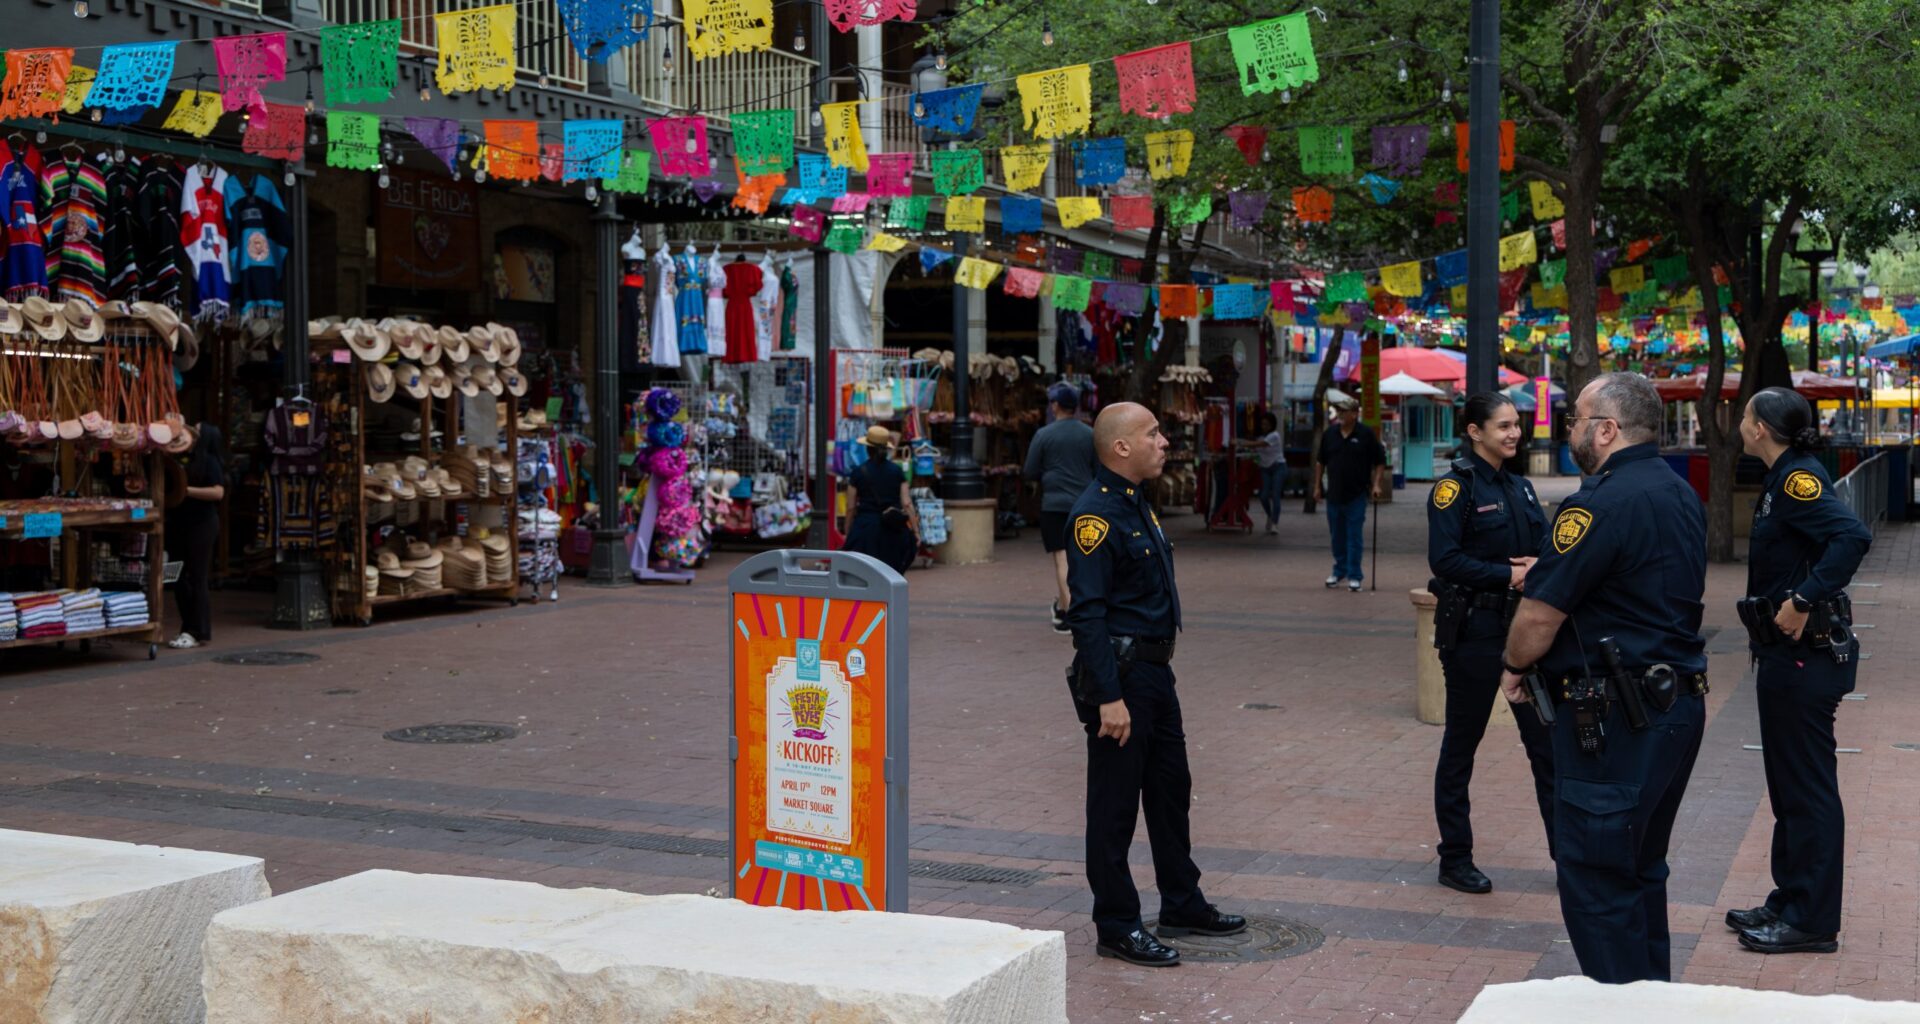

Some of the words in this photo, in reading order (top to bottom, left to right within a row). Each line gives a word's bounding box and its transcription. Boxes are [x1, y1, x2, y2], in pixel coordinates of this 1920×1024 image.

[419, 180, 473, 212] FRIDA
[794, 691, 820, 704] FIESTA
[794, 711, 821, 725] REYES
[783, 740, 834, 766] KICKOFF
[781, 780, 798, 792] APRIL
[820, 785, 837, 798] 12PM
[783, 796, 808, 810] MARKET
[809, 801, 834, 815] SQUARE
